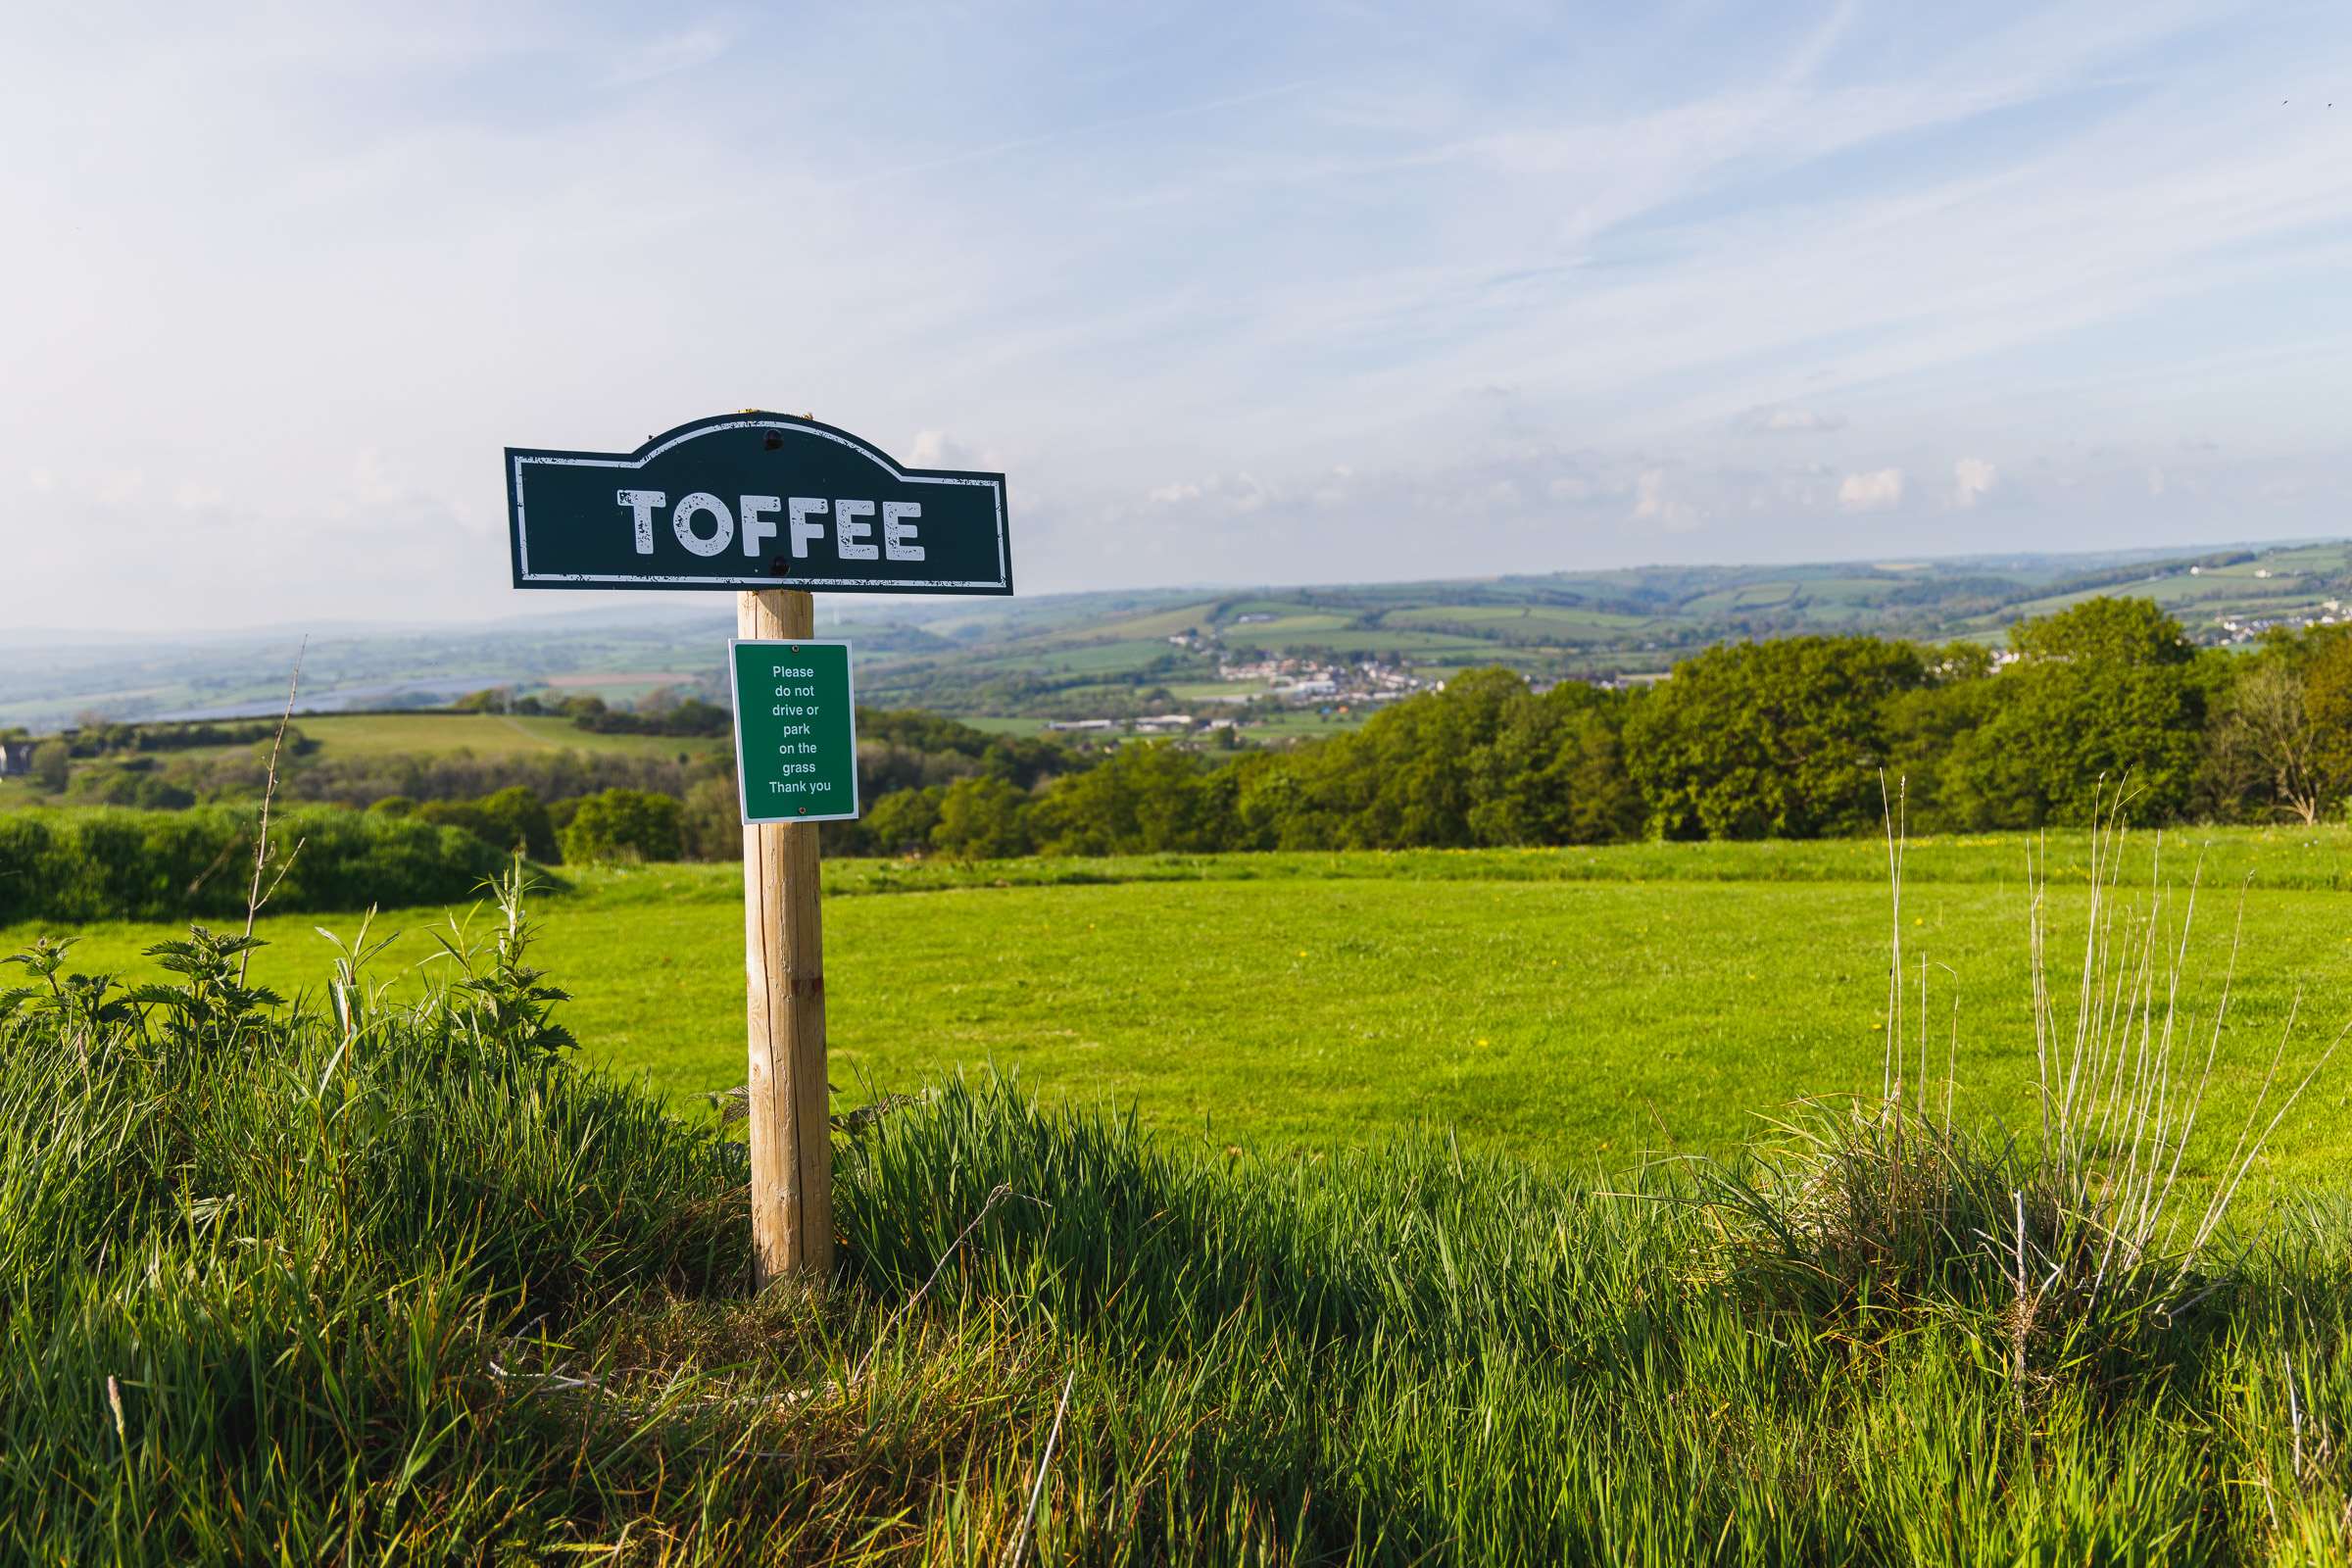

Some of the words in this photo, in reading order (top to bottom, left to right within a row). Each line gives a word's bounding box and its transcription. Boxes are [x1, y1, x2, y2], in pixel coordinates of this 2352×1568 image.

[616, 489, 925, 562] TOFFEE
[772, 665, 814, 678] Please
[774, 685, 791, 697] do
[795, 685, 814, 697] not
[772, 704, 804, 716] drive
[807, 706, 819, 715] or
[783, 722, 810, 737] park
[779, 744, 795, 754] on
[798, 742, 817, 754] the
[782, 763, 816, 776] grass
[768, 780, 807, 793] Thank
[809, 782, 831, 795] you
